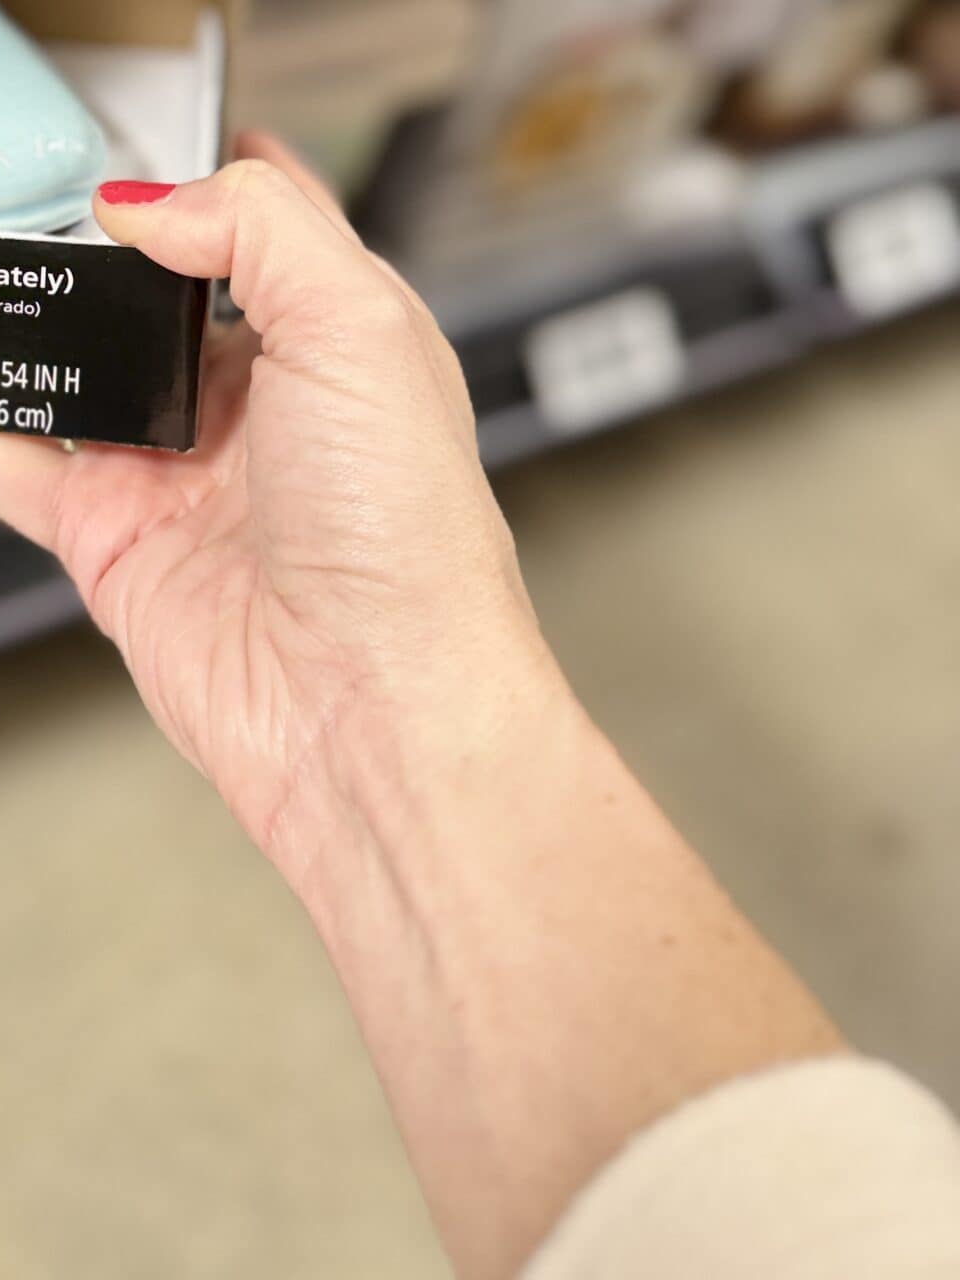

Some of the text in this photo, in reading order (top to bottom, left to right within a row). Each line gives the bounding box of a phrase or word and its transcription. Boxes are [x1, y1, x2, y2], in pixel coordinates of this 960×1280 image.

[34, 363, 58, 392] IN
[64, 366, 81, 394] H
[14, 401, 54, 435] cm)
